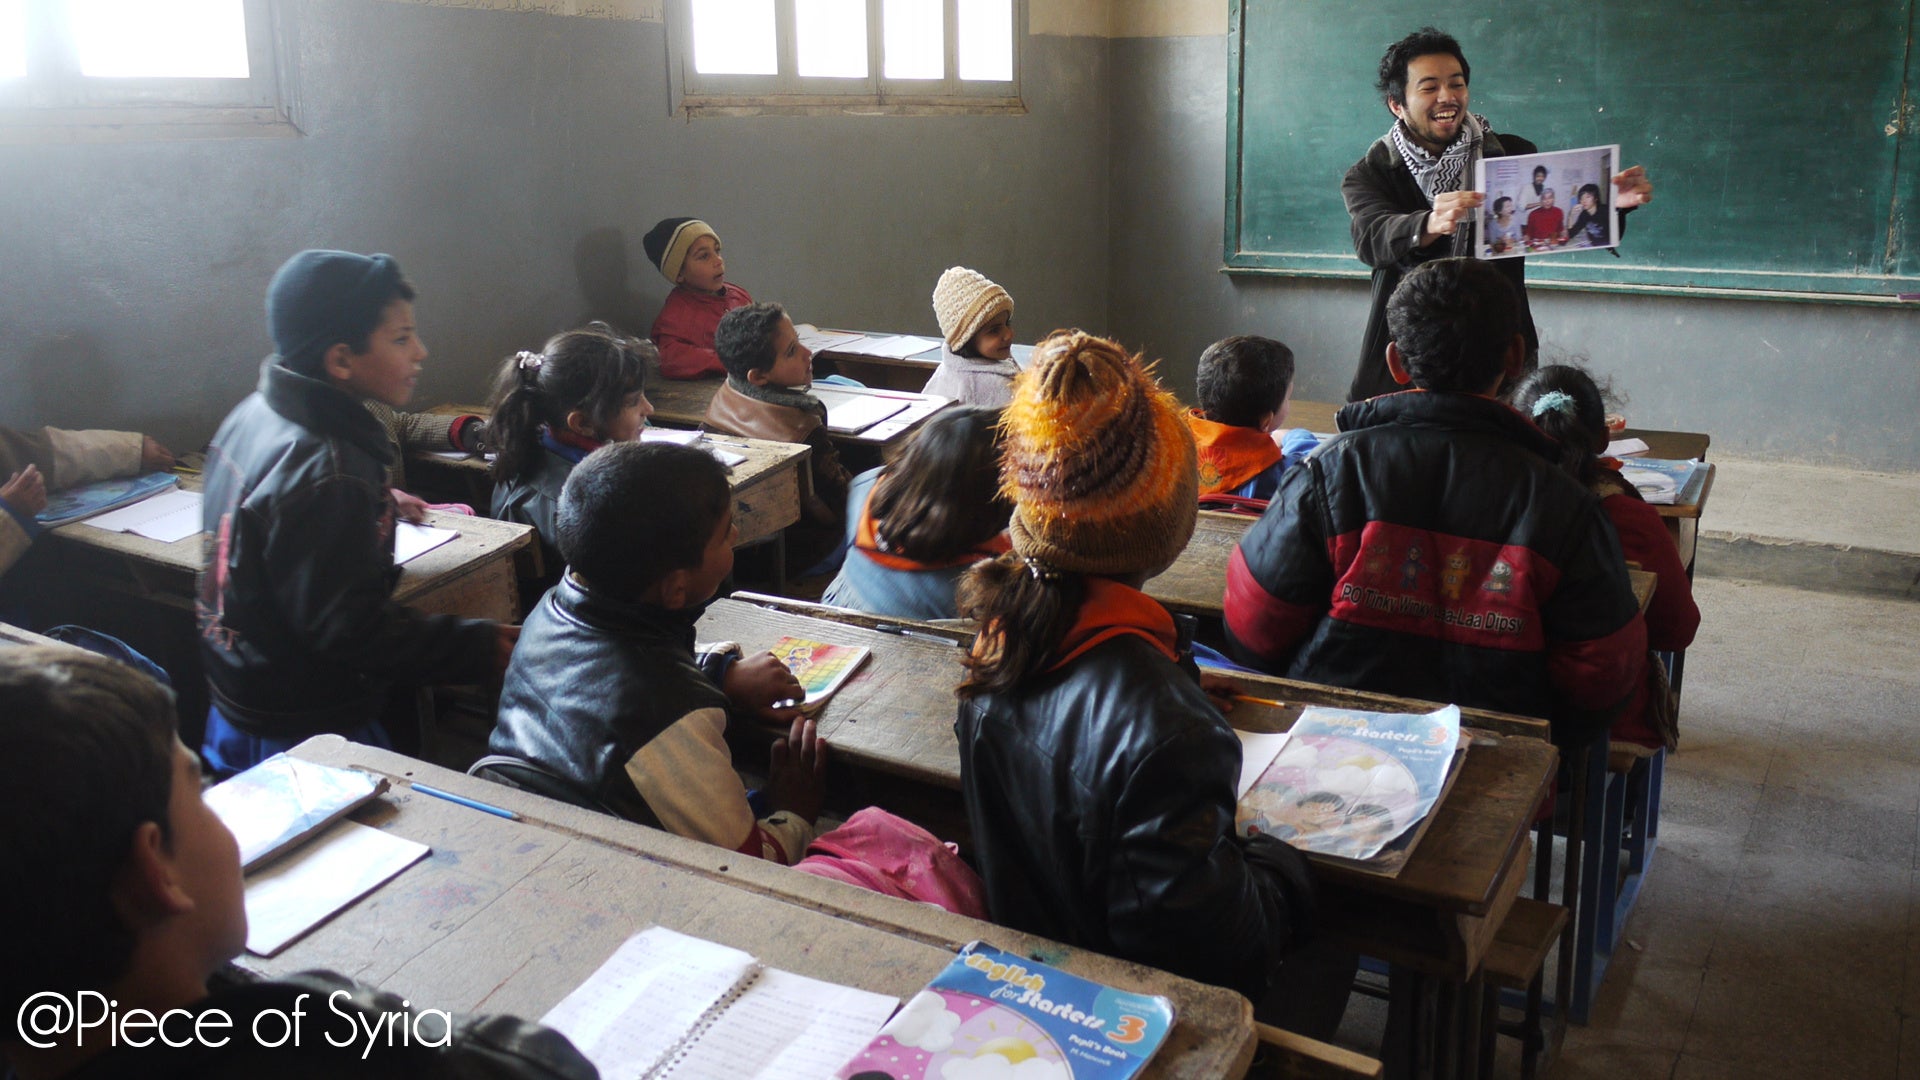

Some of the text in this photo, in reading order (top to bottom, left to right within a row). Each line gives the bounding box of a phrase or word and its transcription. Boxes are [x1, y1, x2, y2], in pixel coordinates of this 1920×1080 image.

[1341, 584, 1363, 605] PO
[1365, 588, 1398, 613] Tinky
[1484, 611, 1525, 636] Dipsy
[1352, 726, 1419, 742] Starters
[1423, 726, 1448, 745] 3
[964, 953, 1045, 993] English
[989, 983, 1020, 999] for
[1016, 989, 1105, 1029] Starters
[1105, 1014, 1147, 1044] 3
[1102, 1045, 1127, 1060] Book
